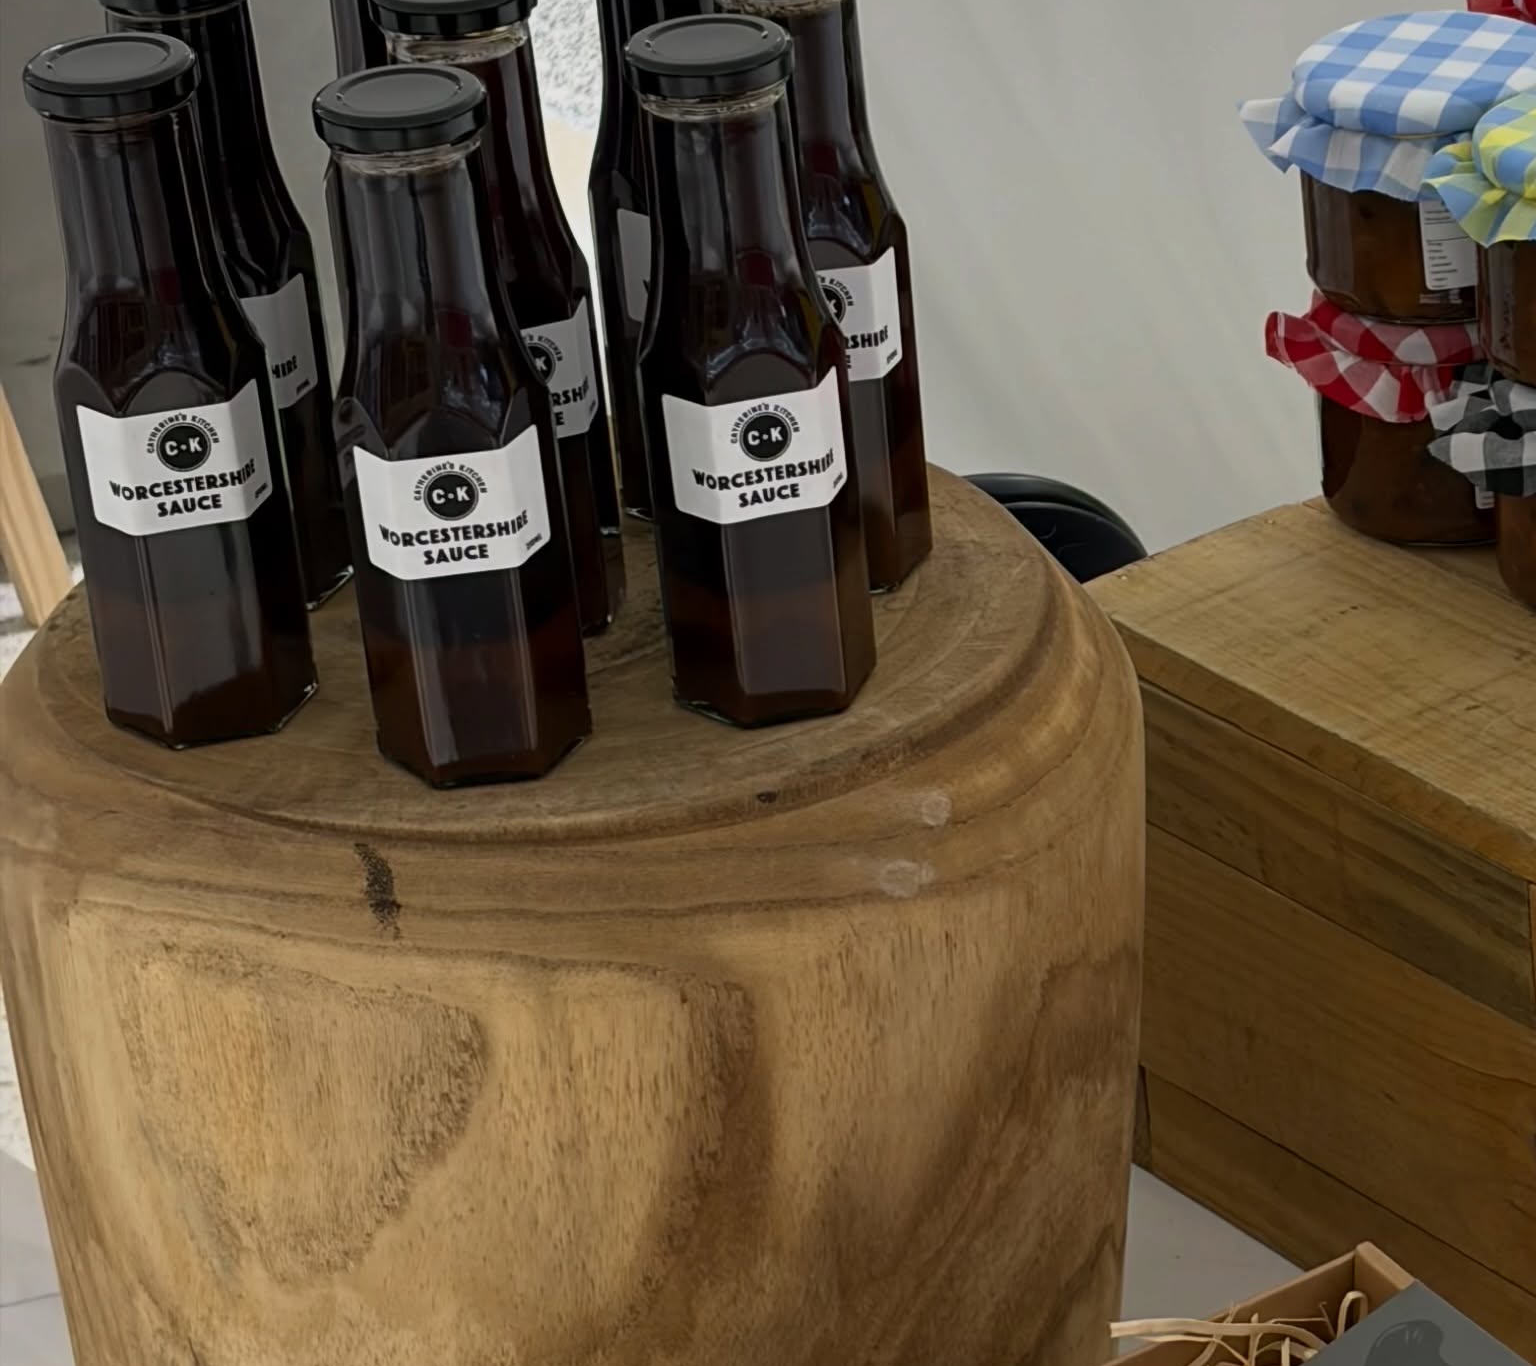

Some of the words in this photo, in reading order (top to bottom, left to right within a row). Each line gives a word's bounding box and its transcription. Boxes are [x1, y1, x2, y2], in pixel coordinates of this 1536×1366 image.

[146, 412, 188, 455] CATHERINE'S
[190, 414, 221, 445] KITCHEN
[729, 402, 770, 444] CATHERINE'S
[773, 404, 801, 434] KITCHEN
[108, 458, 256, 502] WORCESTERSHIRE
[413, 460, 455, 502] CATHERINE'S
[458, 463, 488, 494] KITCHEN
[738, 483, 801, 509] SAUCE
[157, 493, 223, 518] SAUCE
[378, 509, 529, 548] WORCESTERSHIRE
[423, 544, 490, 566] SAUCE
